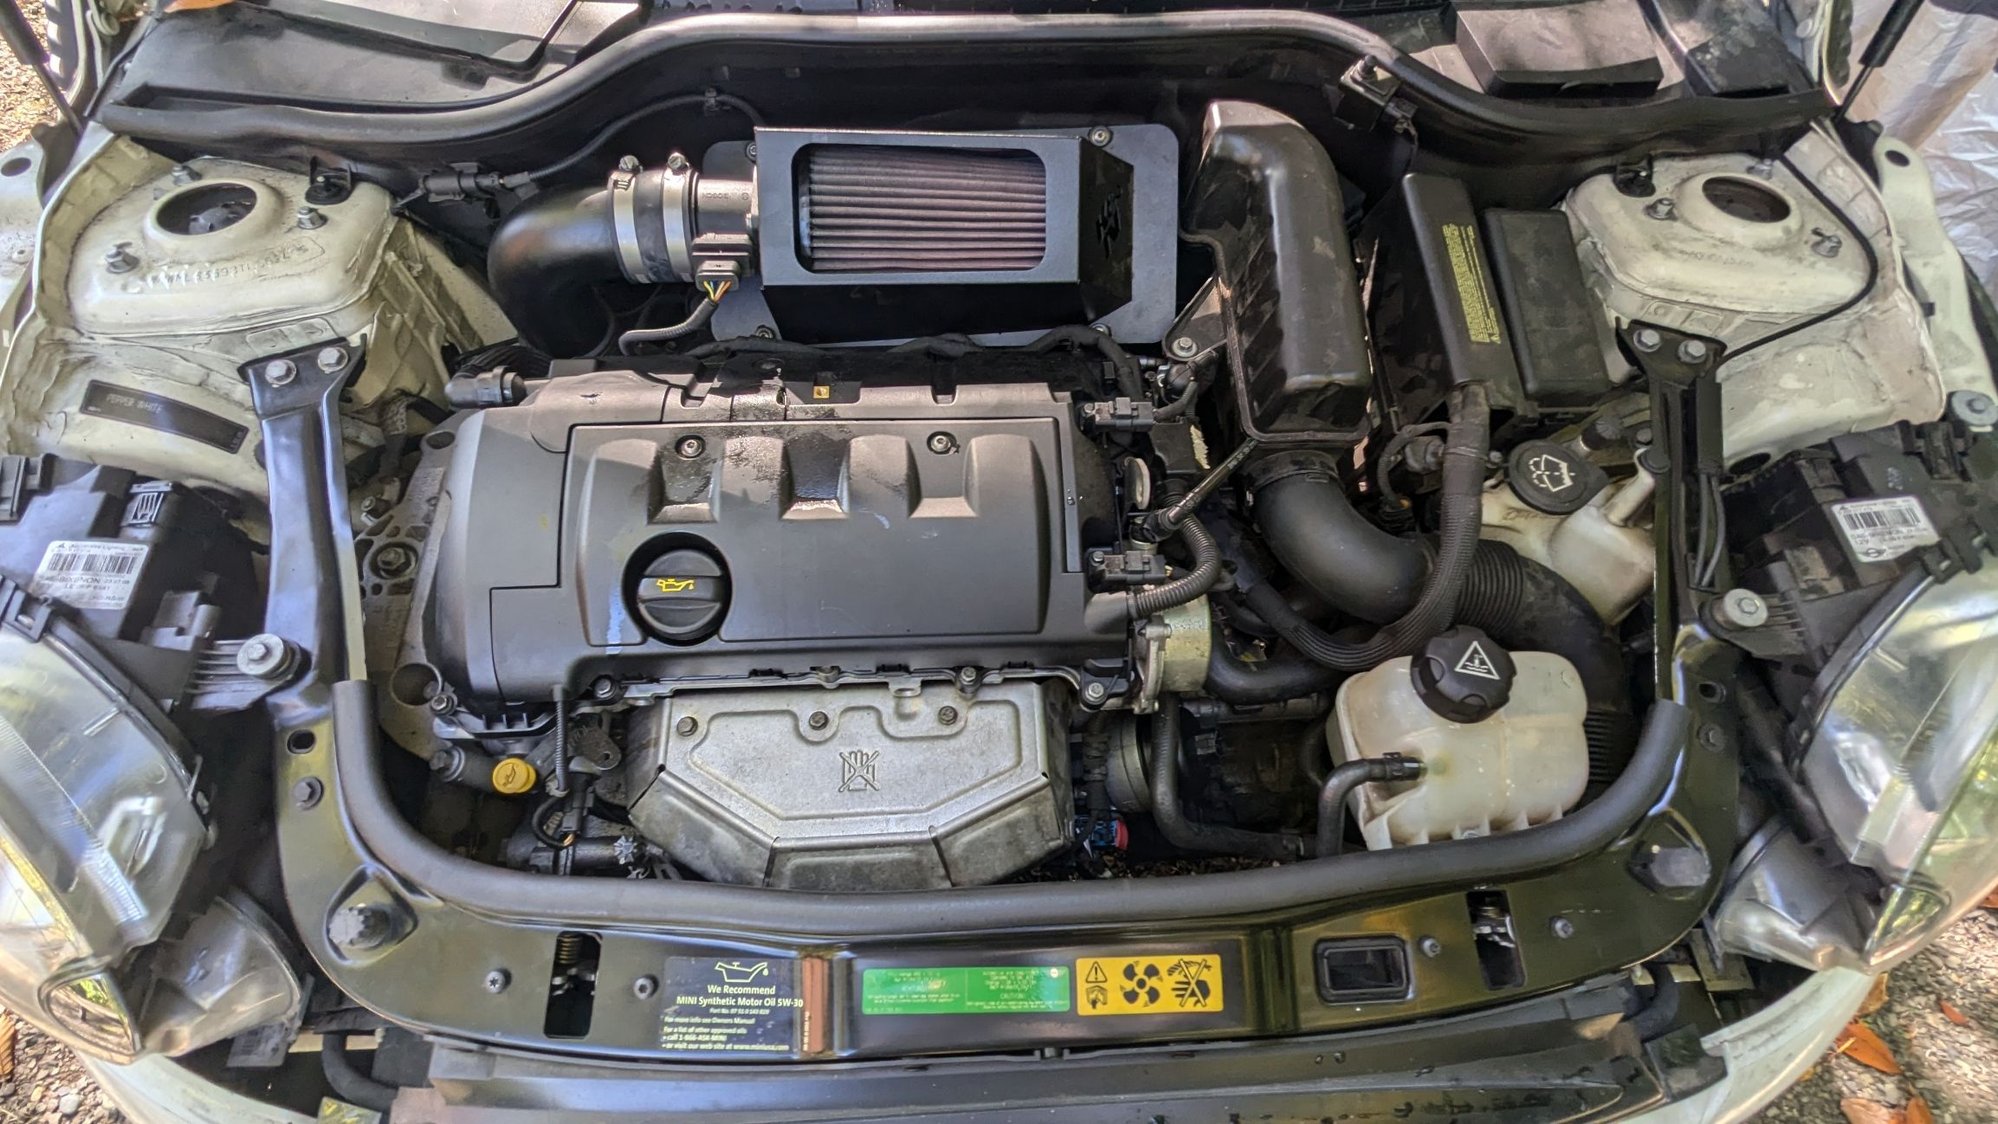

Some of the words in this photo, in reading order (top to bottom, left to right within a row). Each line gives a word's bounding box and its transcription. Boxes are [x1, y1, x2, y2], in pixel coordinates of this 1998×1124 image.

[707, 984, 721, 993] We
[723, 985, 776, 995] Recommend
[676, 996, 697, 1005] MINI
[698, 996, 736, 1007] Synthetic
[737, 997, 763, 1006] Motor
[763, 997, 776, 1007] Oil
[777, 998, 804, 1008] 5W-30
